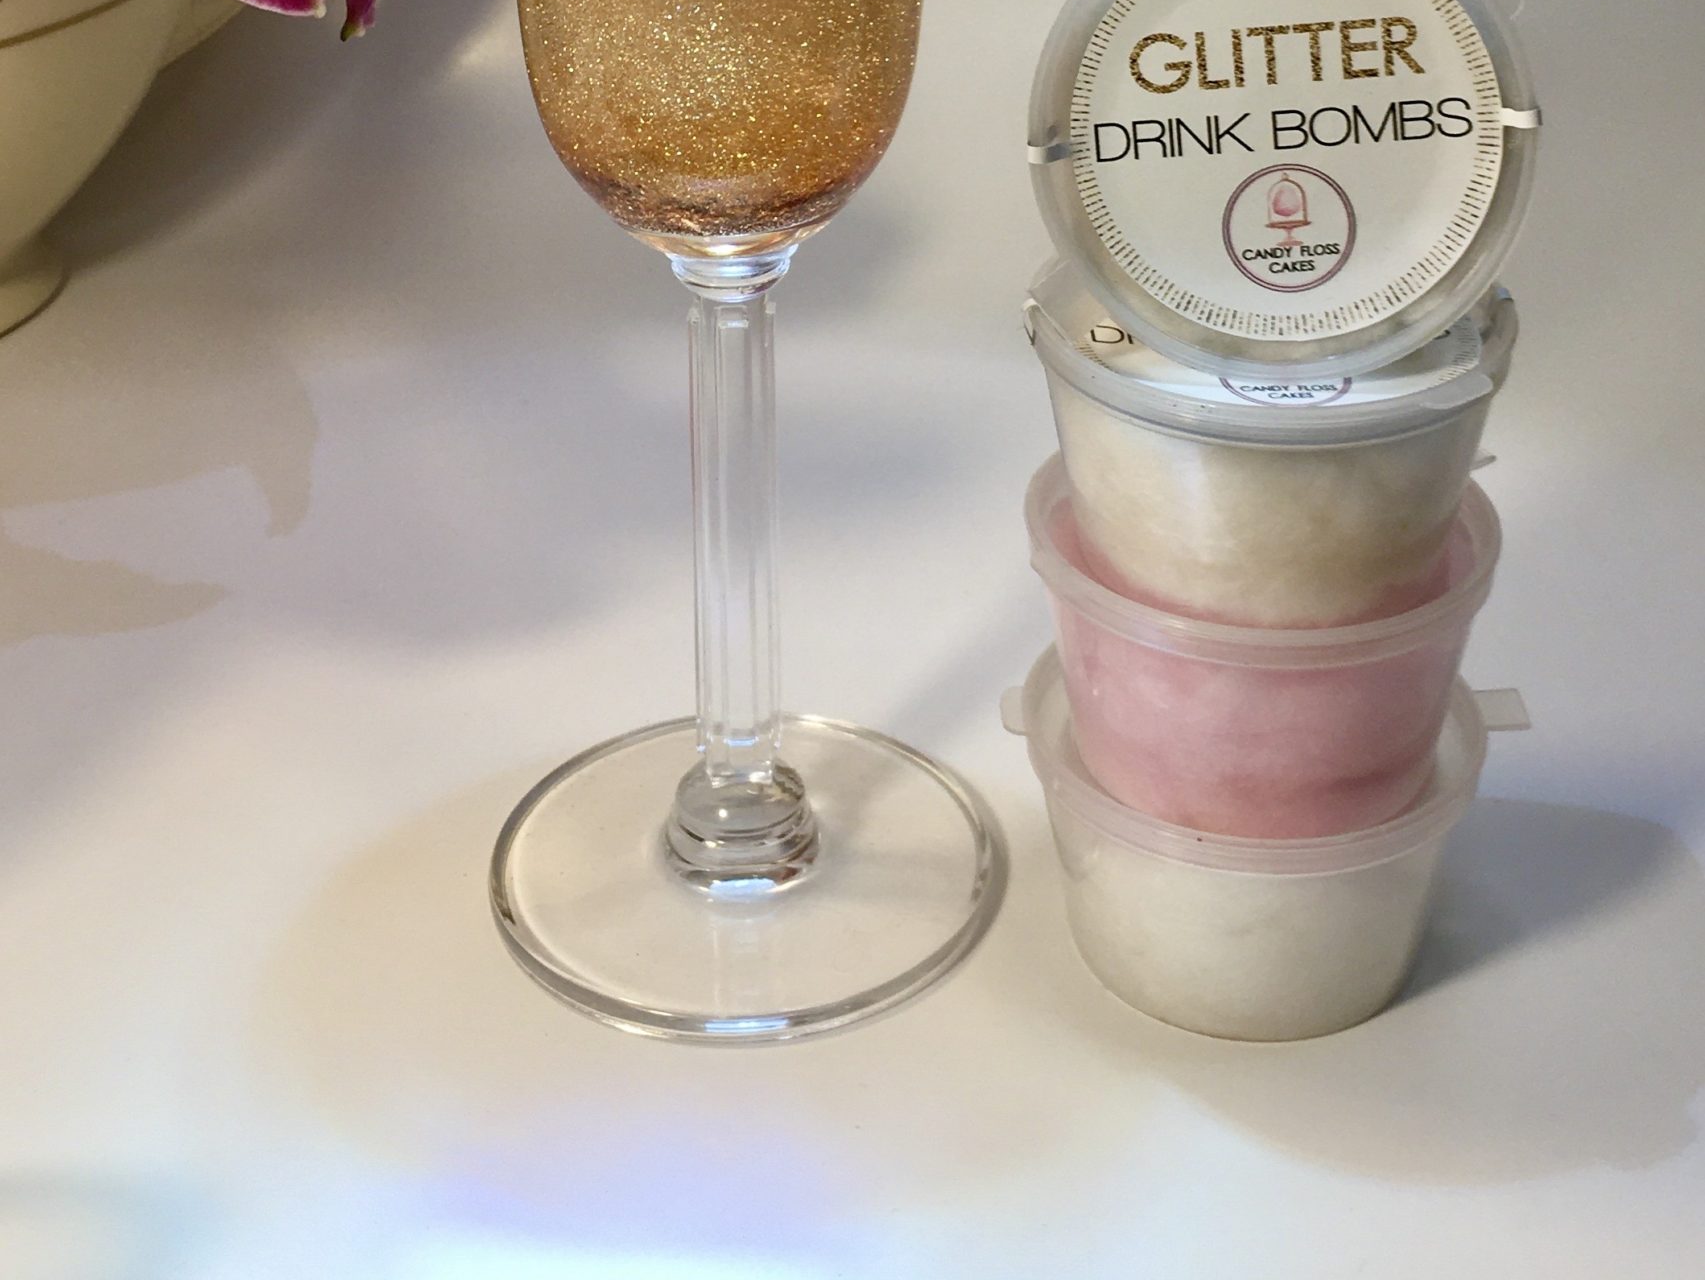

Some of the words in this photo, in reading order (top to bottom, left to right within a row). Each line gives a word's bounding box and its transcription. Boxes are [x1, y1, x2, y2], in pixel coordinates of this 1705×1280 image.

[1128, 16, 1426, 95] GLITTER
[1093, 112, 1255, 163] DRINK
[1270, 97, 1474, 151] BOMBS
[1241, 246, 1293, 261] CANDY
[1300, 243, 1341, 257] FLOSS
[1268, 259, 1316, 274] CAKES
[1239, 384, 1291, 392] CANDY
[1296, 384, 1339, 392] FLOSS
